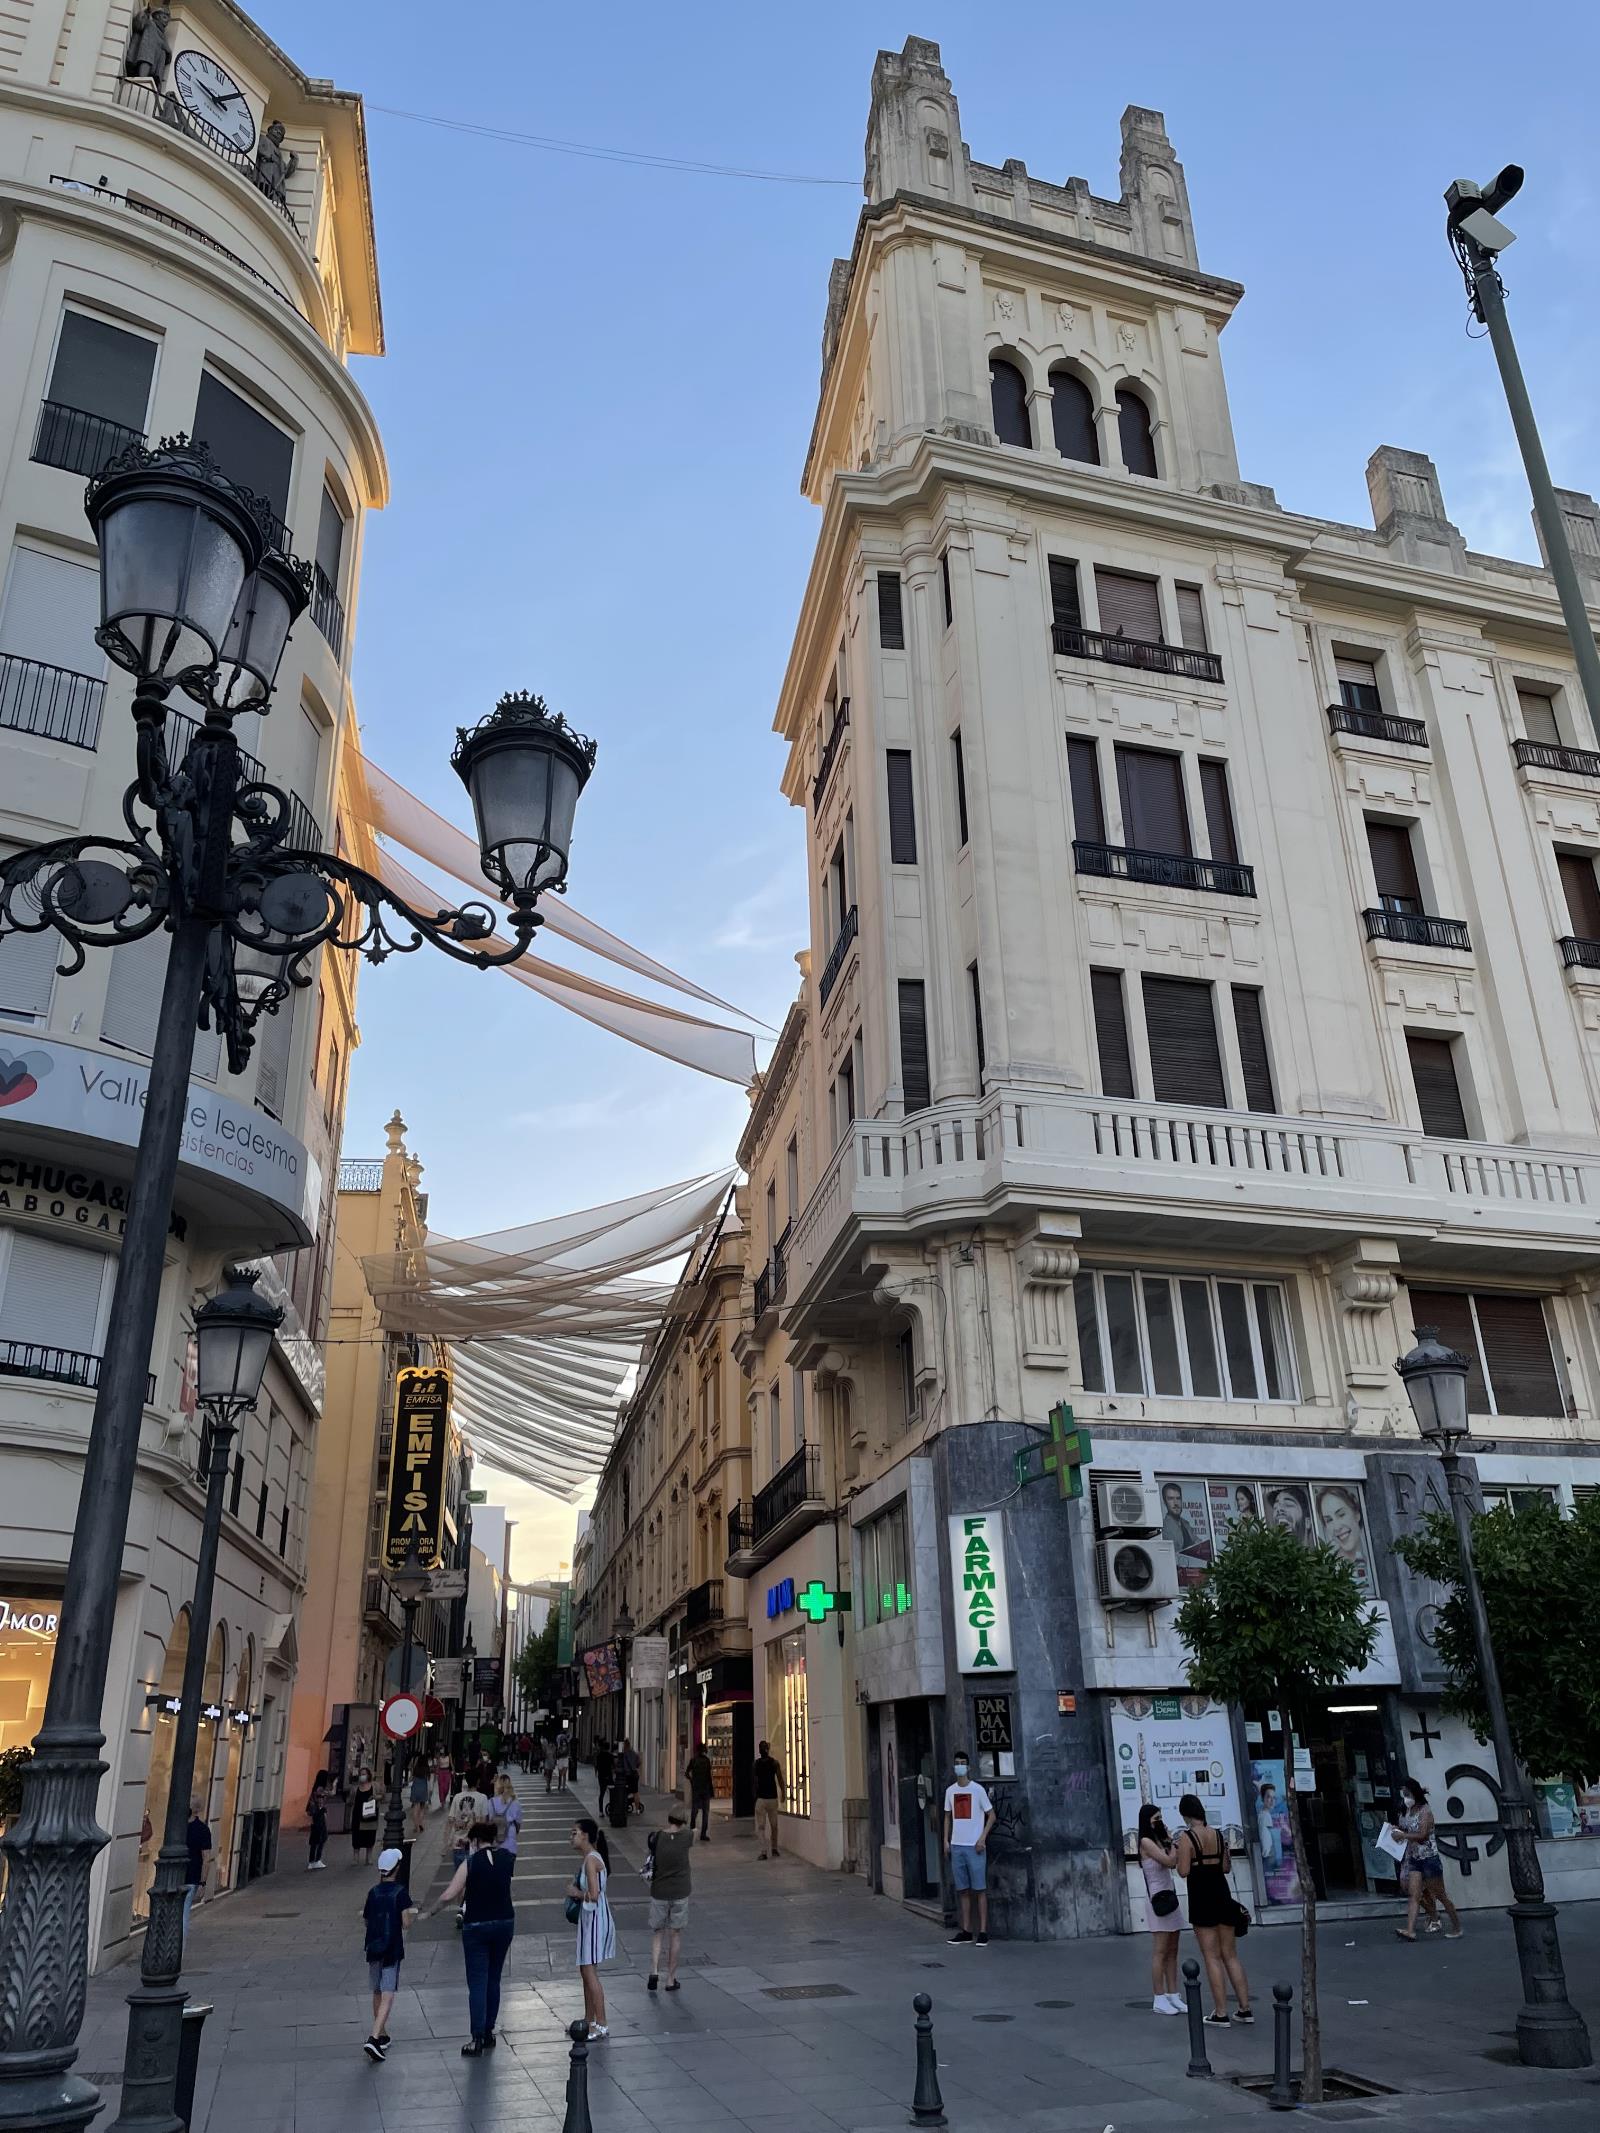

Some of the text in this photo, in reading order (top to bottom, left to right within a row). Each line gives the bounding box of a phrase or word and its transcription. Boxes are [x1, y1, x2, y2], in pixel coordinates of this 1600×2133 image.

[215, 1108, 298, 1176] ledesma
[179, 1132, 255, 1176] sistencias
[405, 1395, 443, 1404] EMFISA
[400, 1413, 434, 1532] EMFISA
[1189, 1510, 1204, 1518] VIDA
[390, 1537, 434, 1546] PROMORA
[963, 1517, 999, 1668] FARMACIA
[977, 1699, 1007, 1714] FAR
[980, 1714, 1005, 1729] MA
[1162, 1740, 1188, 1750] ampoule
[1181, 1748, 1196, 1757] your
